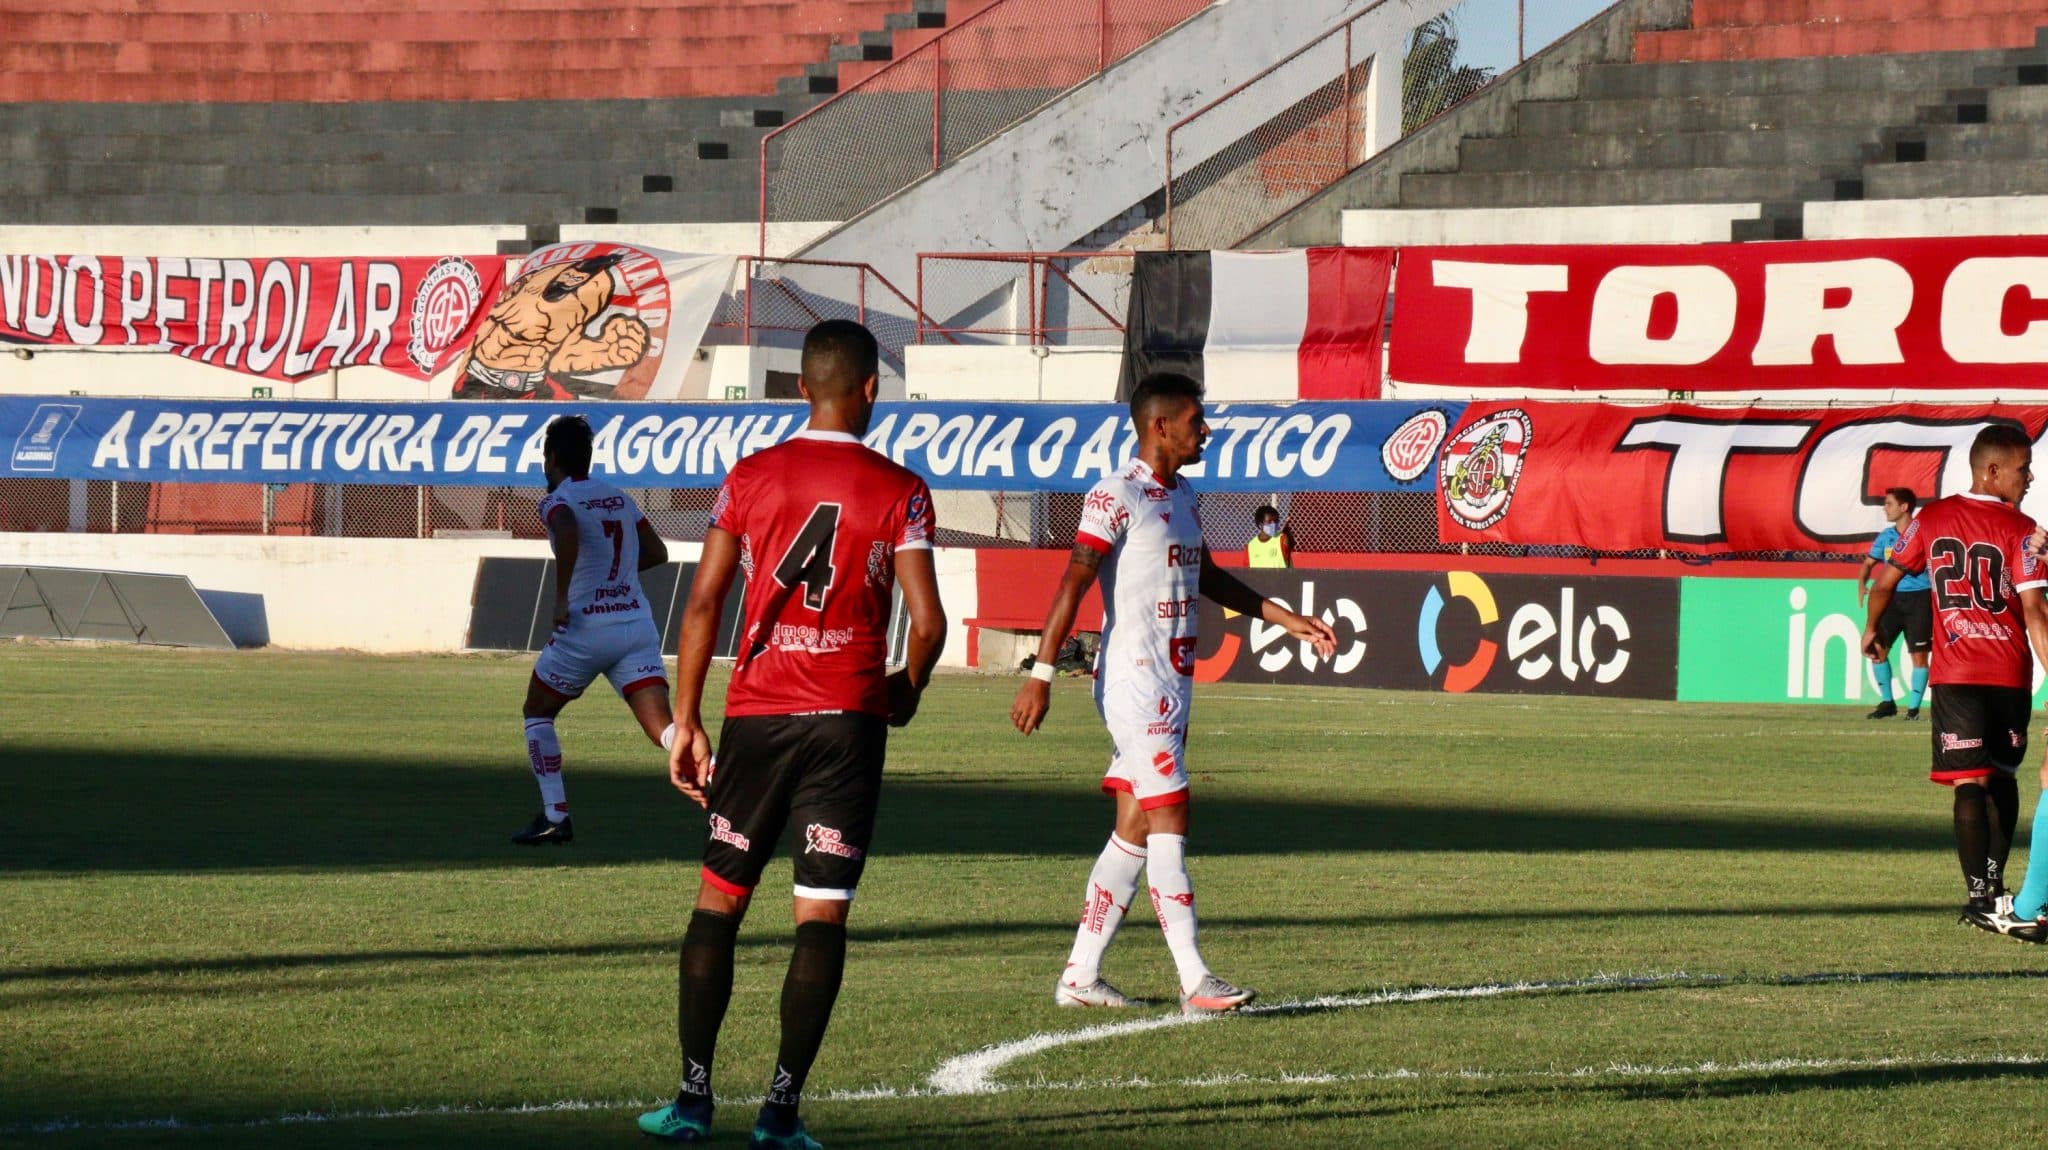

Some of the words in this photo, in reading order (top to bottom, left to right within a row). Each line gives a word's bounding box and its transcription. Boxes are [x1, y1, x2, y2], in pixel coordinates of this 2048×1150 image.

[121, 256, 402, 376] PETROLAR
[1432, 257, 2048, 366] TORC
[92, 410, 133, 469] A
[139, 411, 442, 472] PREFEITURA
[444, 414, 528, 473] DE
[861, 412, 1024, 478] APOIA
[1028, 416, 1077, 479] O
[1612, 414, 2048, 546] TO
[601, 519, 624, 581] 7
[773, 502, 842, 612] 4
[1168, 543, 1201, 568] Rizz
[1931, 537, 2008, 614] 20
[1507, 587, 1631, 684] elo
